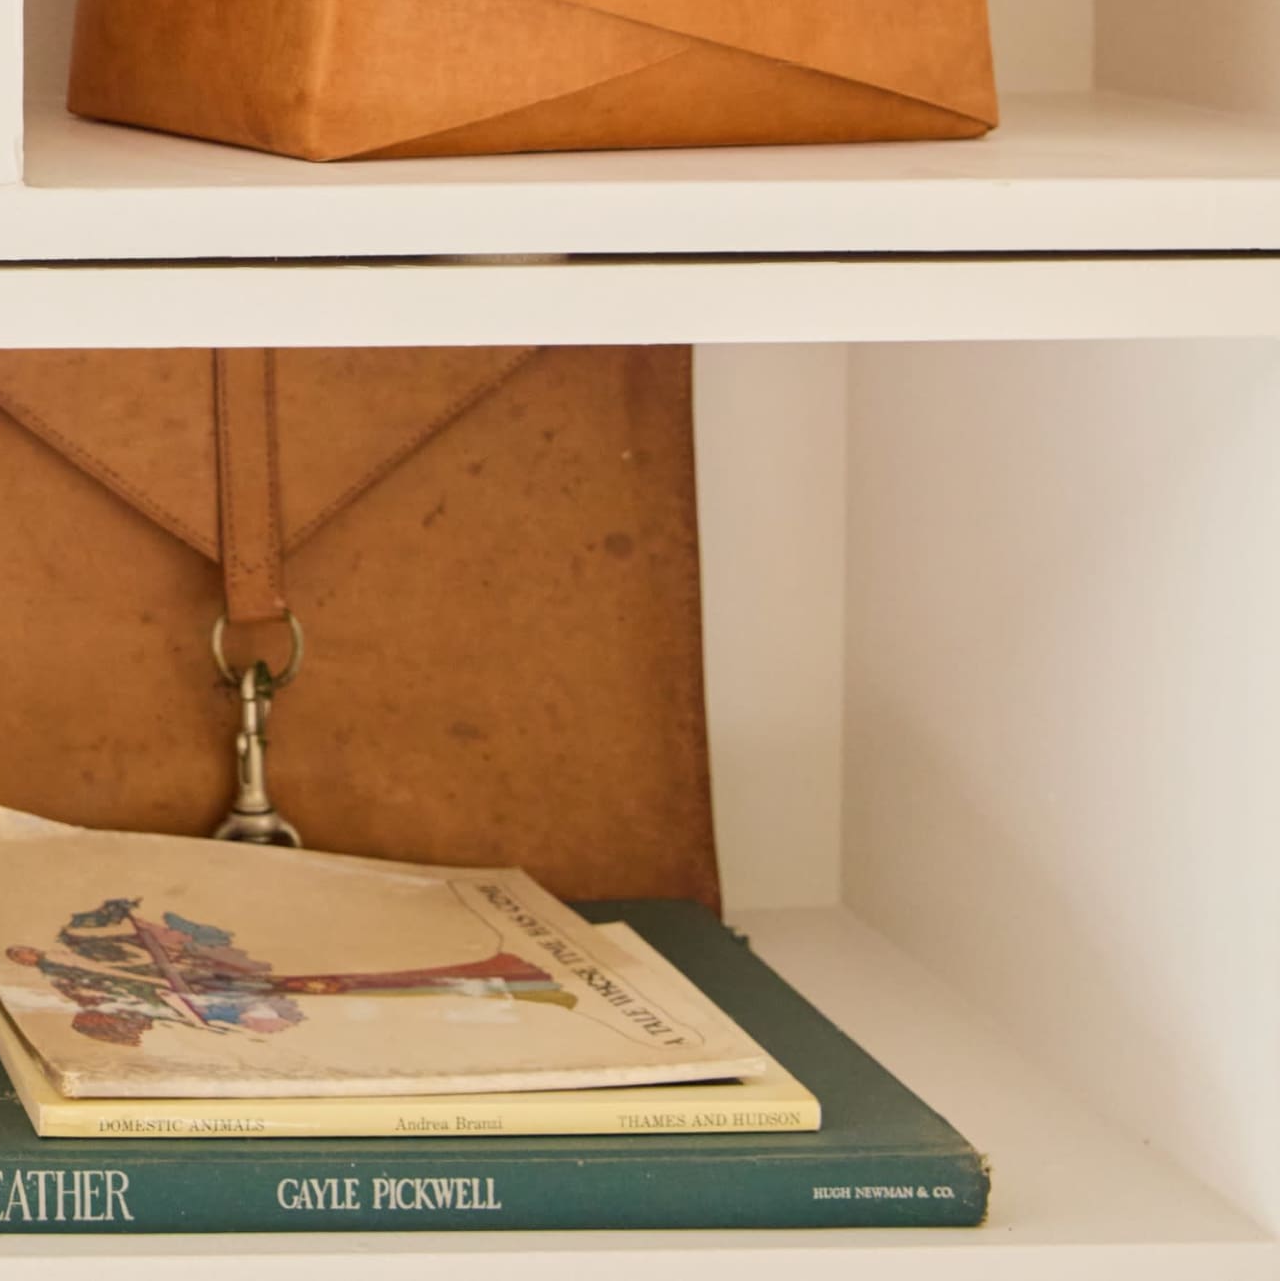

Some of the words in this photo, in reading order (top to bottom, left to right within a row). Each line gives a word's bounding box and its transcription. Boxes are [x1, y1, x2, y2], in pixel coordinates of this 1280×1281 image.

[99, 1119, 183, 1132] DOMESTIC
[189, 1119, 265, 1132] ANIMALS
[395, 1117, 449, 1131] Andrea
[618, 1114, 686, 1129] THAMES
[691, 1114, 728, 1128] AND
[731, 1112, 802, 1127] HUDSON
[276, 1177, 360, 1210] GAYLE
[371, 1176, 502, 1210] PICKWELL
[813, 1186, 851, 1200] HUGH
[855, 1186, 913, 1199] NEWMAN
[916, 1186, 929, 1199] &
[932, 1186, 956, 1200] CO.
